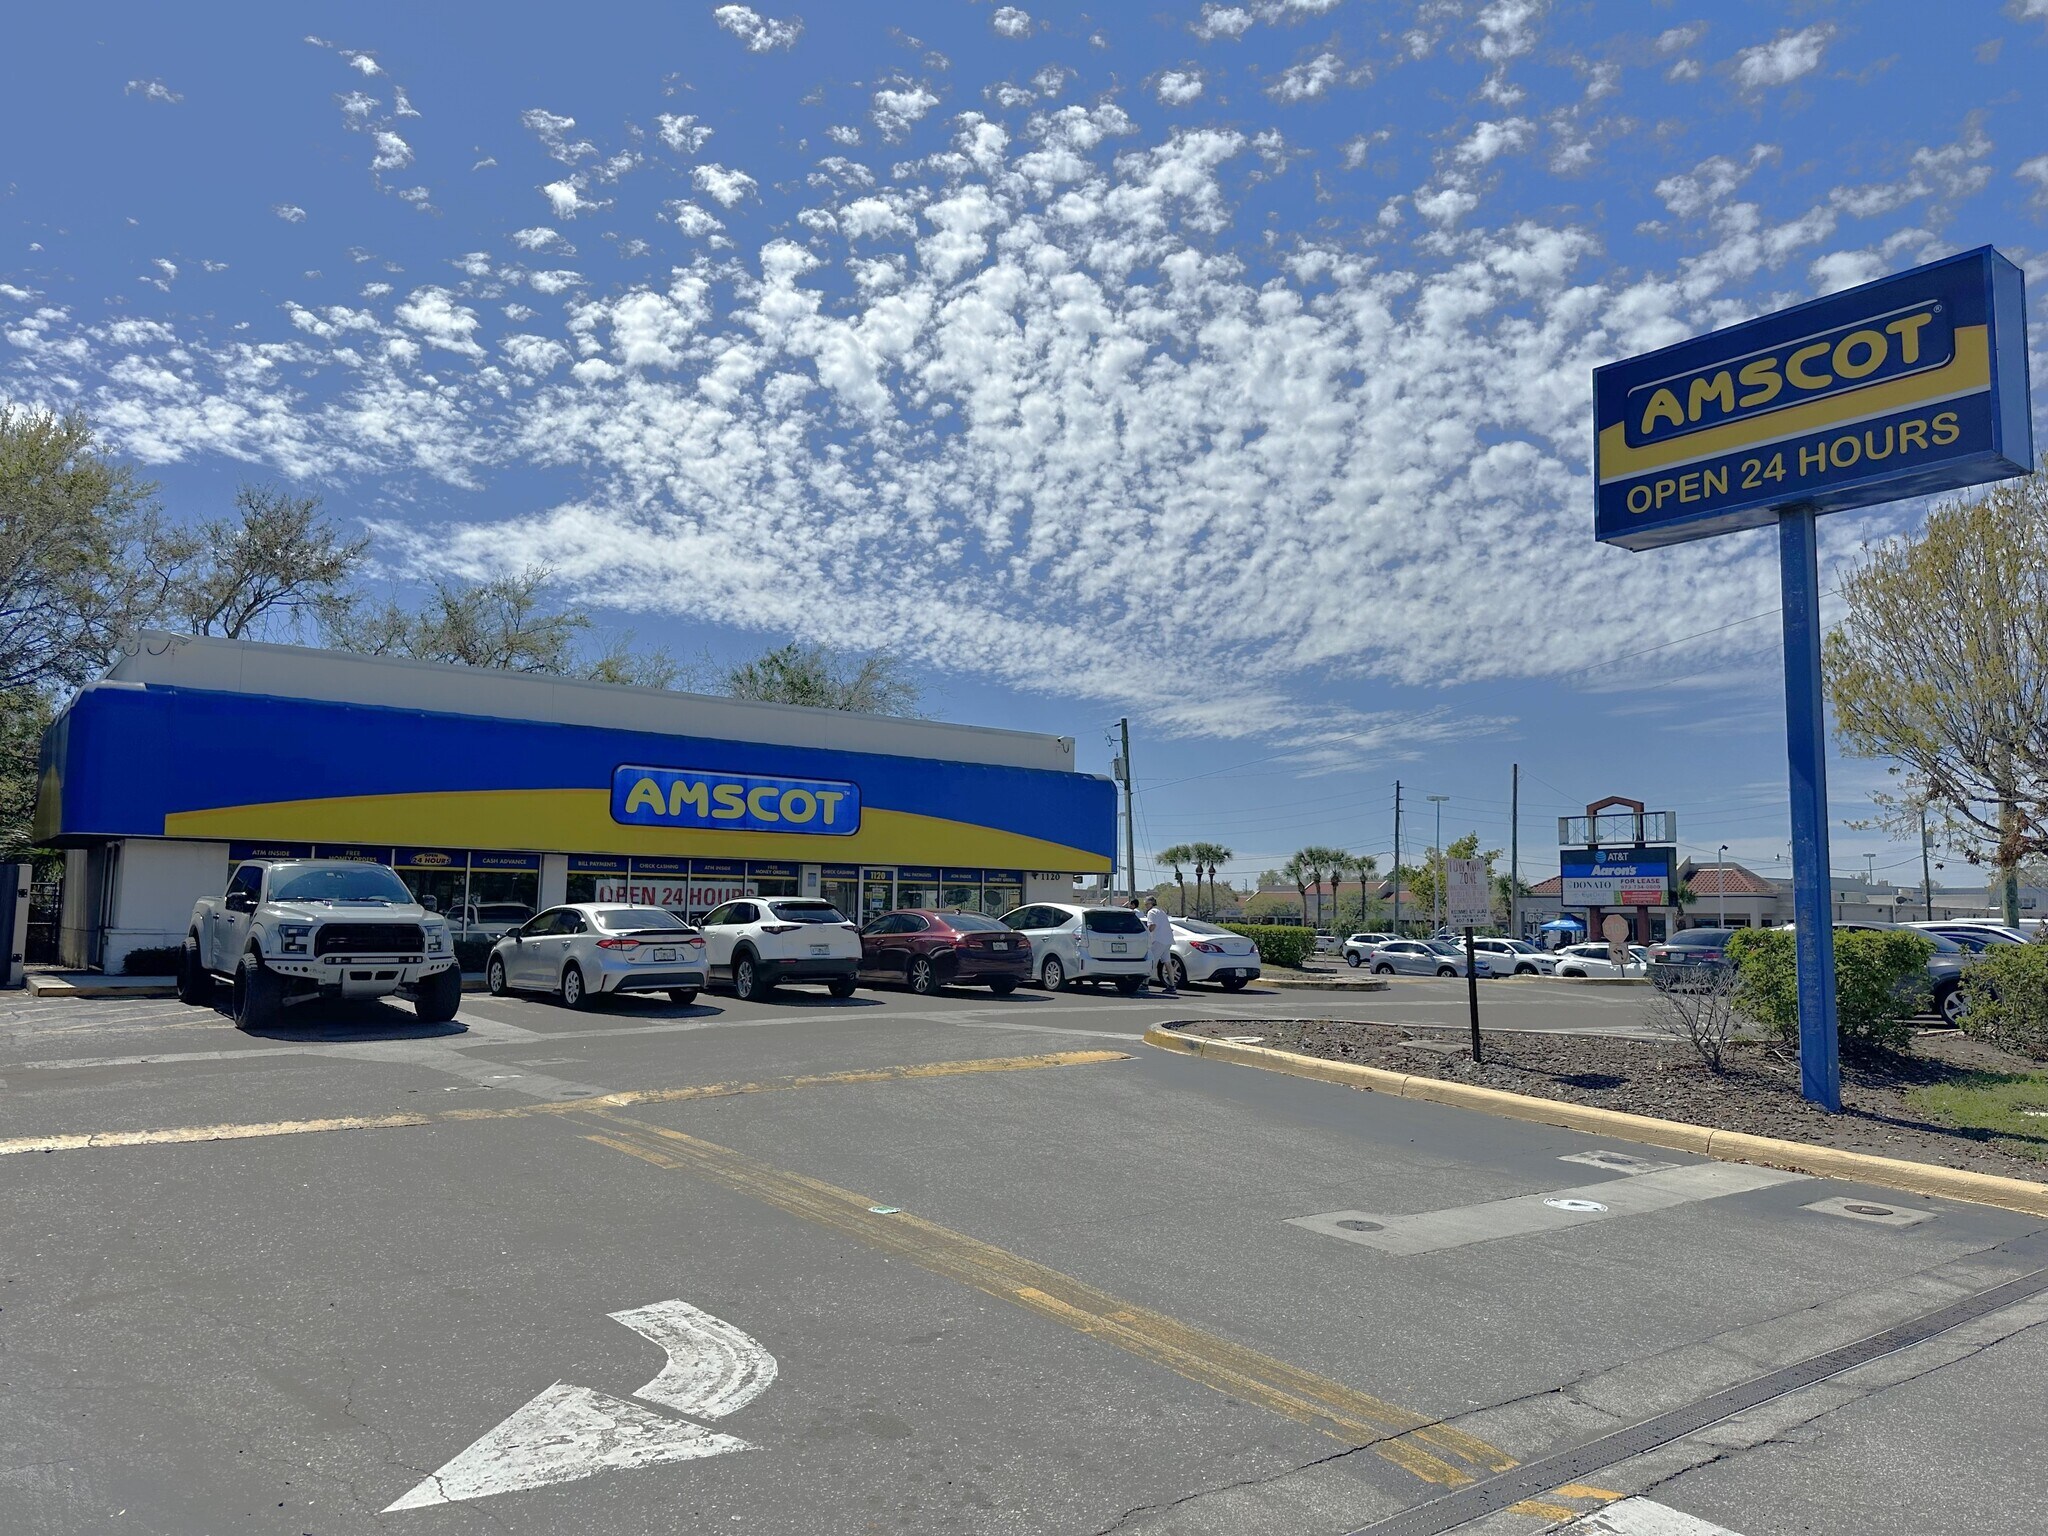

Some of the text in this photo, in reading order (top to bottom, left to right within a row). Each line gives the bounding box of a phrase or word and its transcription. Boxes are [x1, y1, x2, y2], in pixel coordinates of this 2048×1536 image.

[1641, 312, 1932, 434] AMSCOT
[1626, 412, 1960, 514] OPEN 24 HOURS
[625, 777, 844, 825] AMSCOT
[424, 857, 450, 865] HOURS
[500, 857, 527, 865] ADVANCE
[1607, 852, 1629, 861] AT&T
[1591, 864, 1638, 876] Aaron's
[870, 871, 886, 880] 1120
[1041, 873, 1060, 881] 1120
[1459, 872, 1477, 885] ZONE
[1573, 881, 1612, 889] DONATO
[600, 885, 656, 905] OPEN
[661, 886, 683, 906] 24
